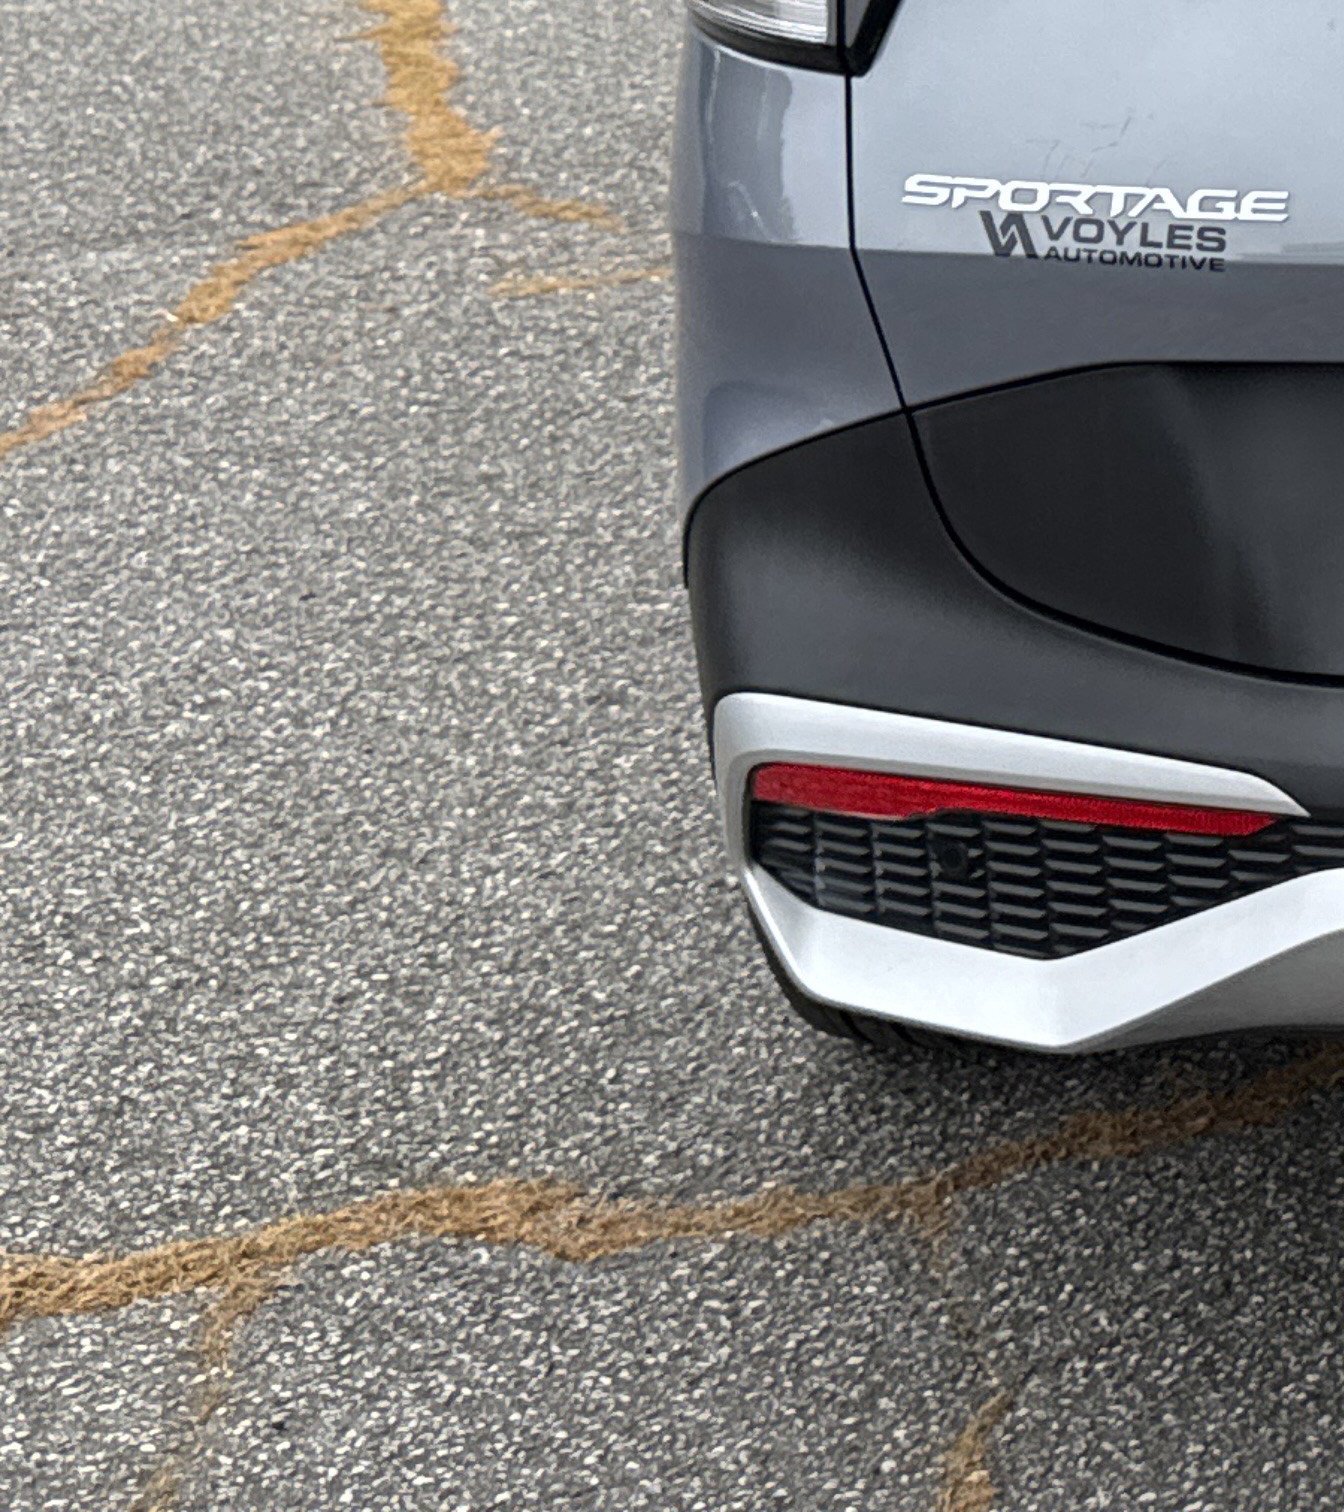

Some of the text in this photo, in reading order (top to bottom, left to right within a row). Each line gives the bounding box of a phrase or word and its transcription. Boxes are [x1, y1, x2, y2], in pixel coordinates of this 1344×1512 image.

[902, 173, 1289, 222] SPORTAGE
[1041, 215, 1226, 253] VOYLES
[1045, 245, 1226, 272] AUTOMOTIVE
